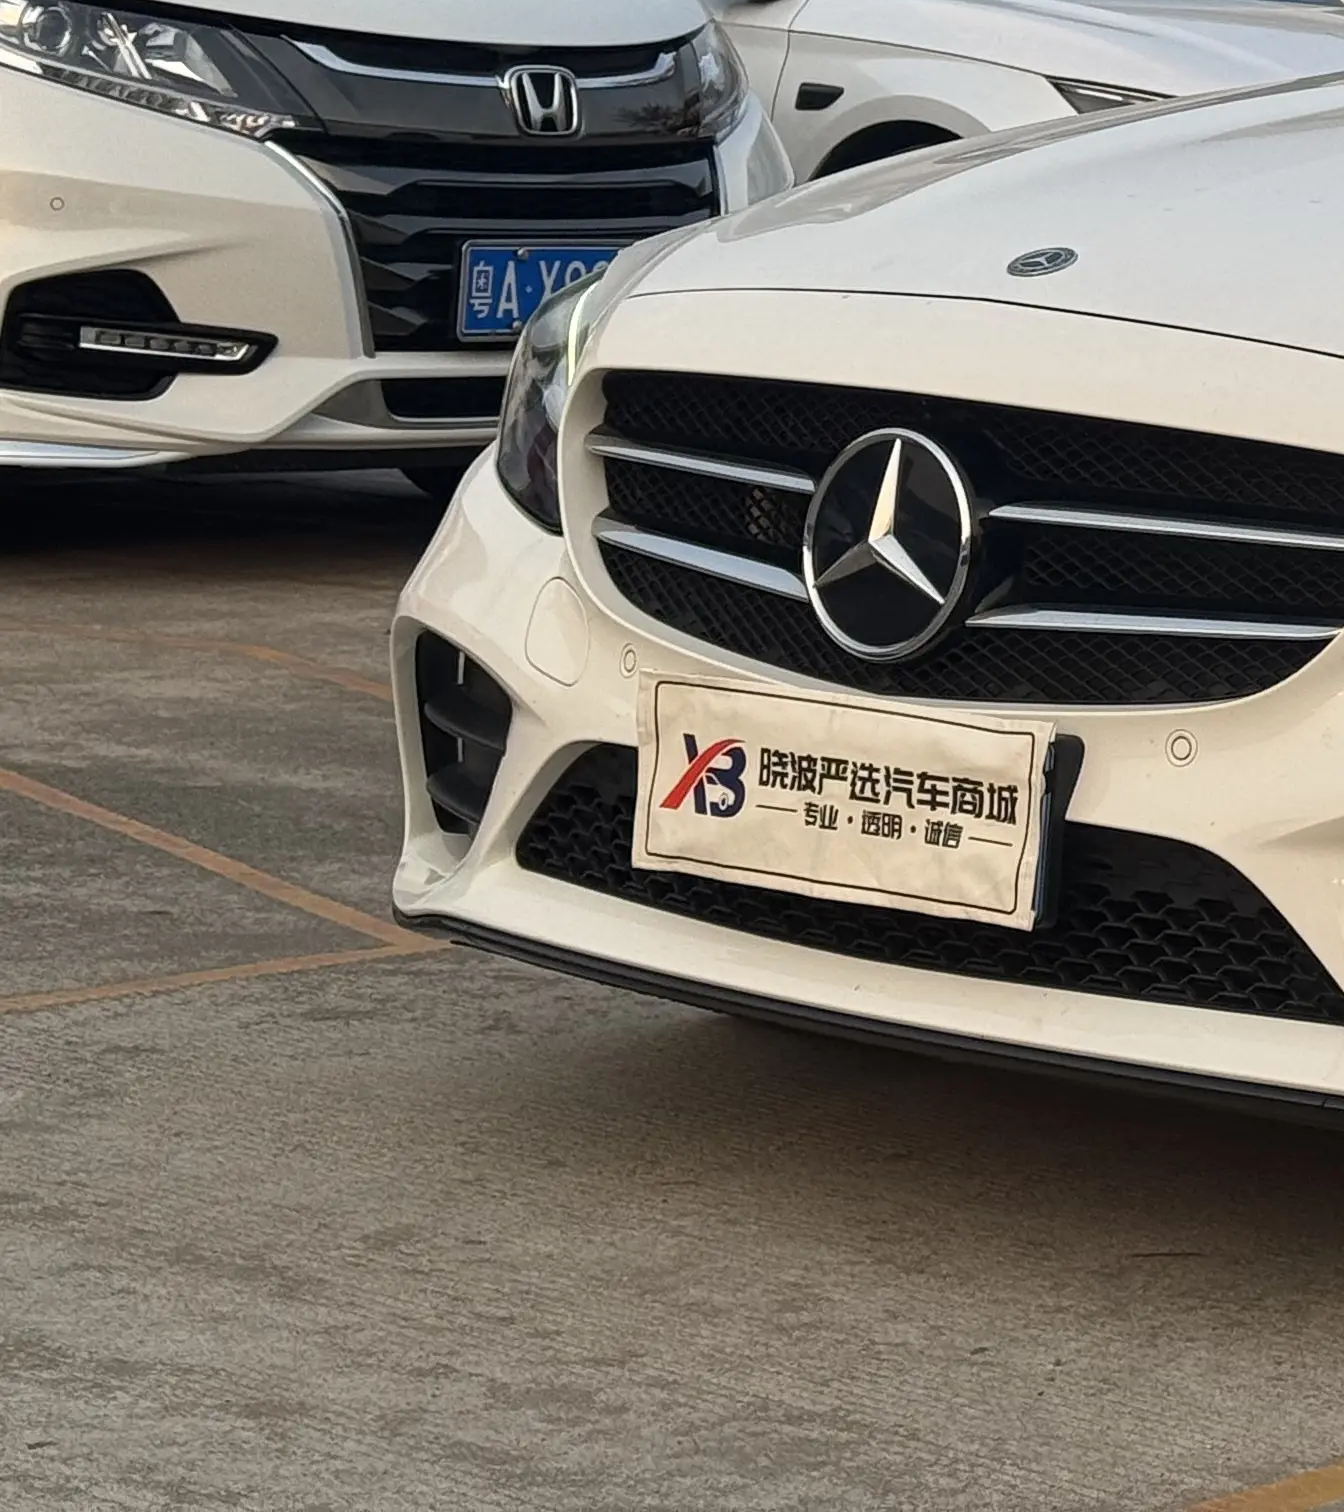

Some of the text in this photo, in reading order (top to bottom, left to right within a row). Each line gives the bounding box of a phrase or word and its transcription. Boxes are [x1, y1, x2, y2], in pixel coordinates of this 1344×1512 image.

[757, 747, 1019, 826] 晓波严选汽车商城
